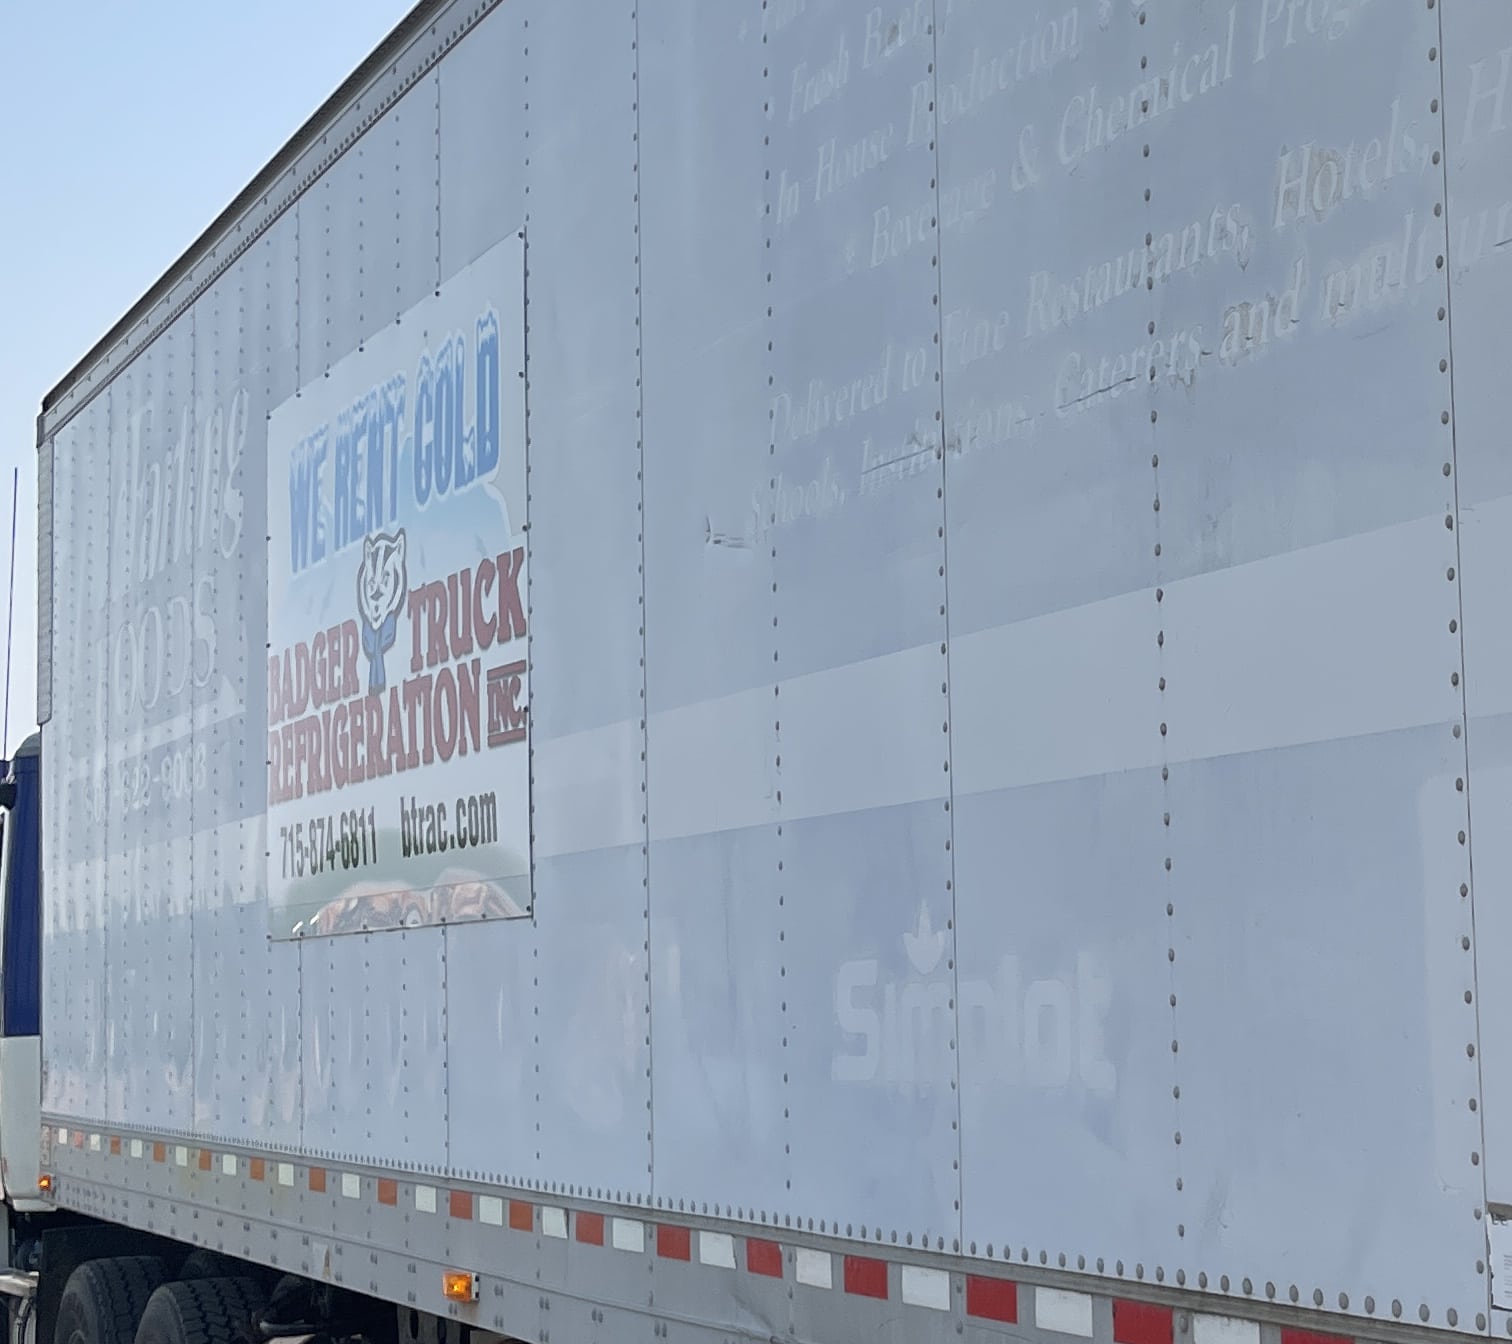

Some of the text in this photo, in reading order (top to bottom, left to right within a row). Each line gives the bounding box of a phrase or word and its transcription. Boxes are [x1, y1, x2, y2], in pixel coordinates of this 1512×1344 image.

[1057, 4, 1237, 166] Chemical
[1218, 258, 1306, 358] and
[288, 308, 500, 573] WE RENT COLD
[269, 547, 526, 722] BADGER TRUCK
[268, 658, 481, 805] REFRIGERATION
[280, 791, 498, 878] 715-874-6811 btrac.com
